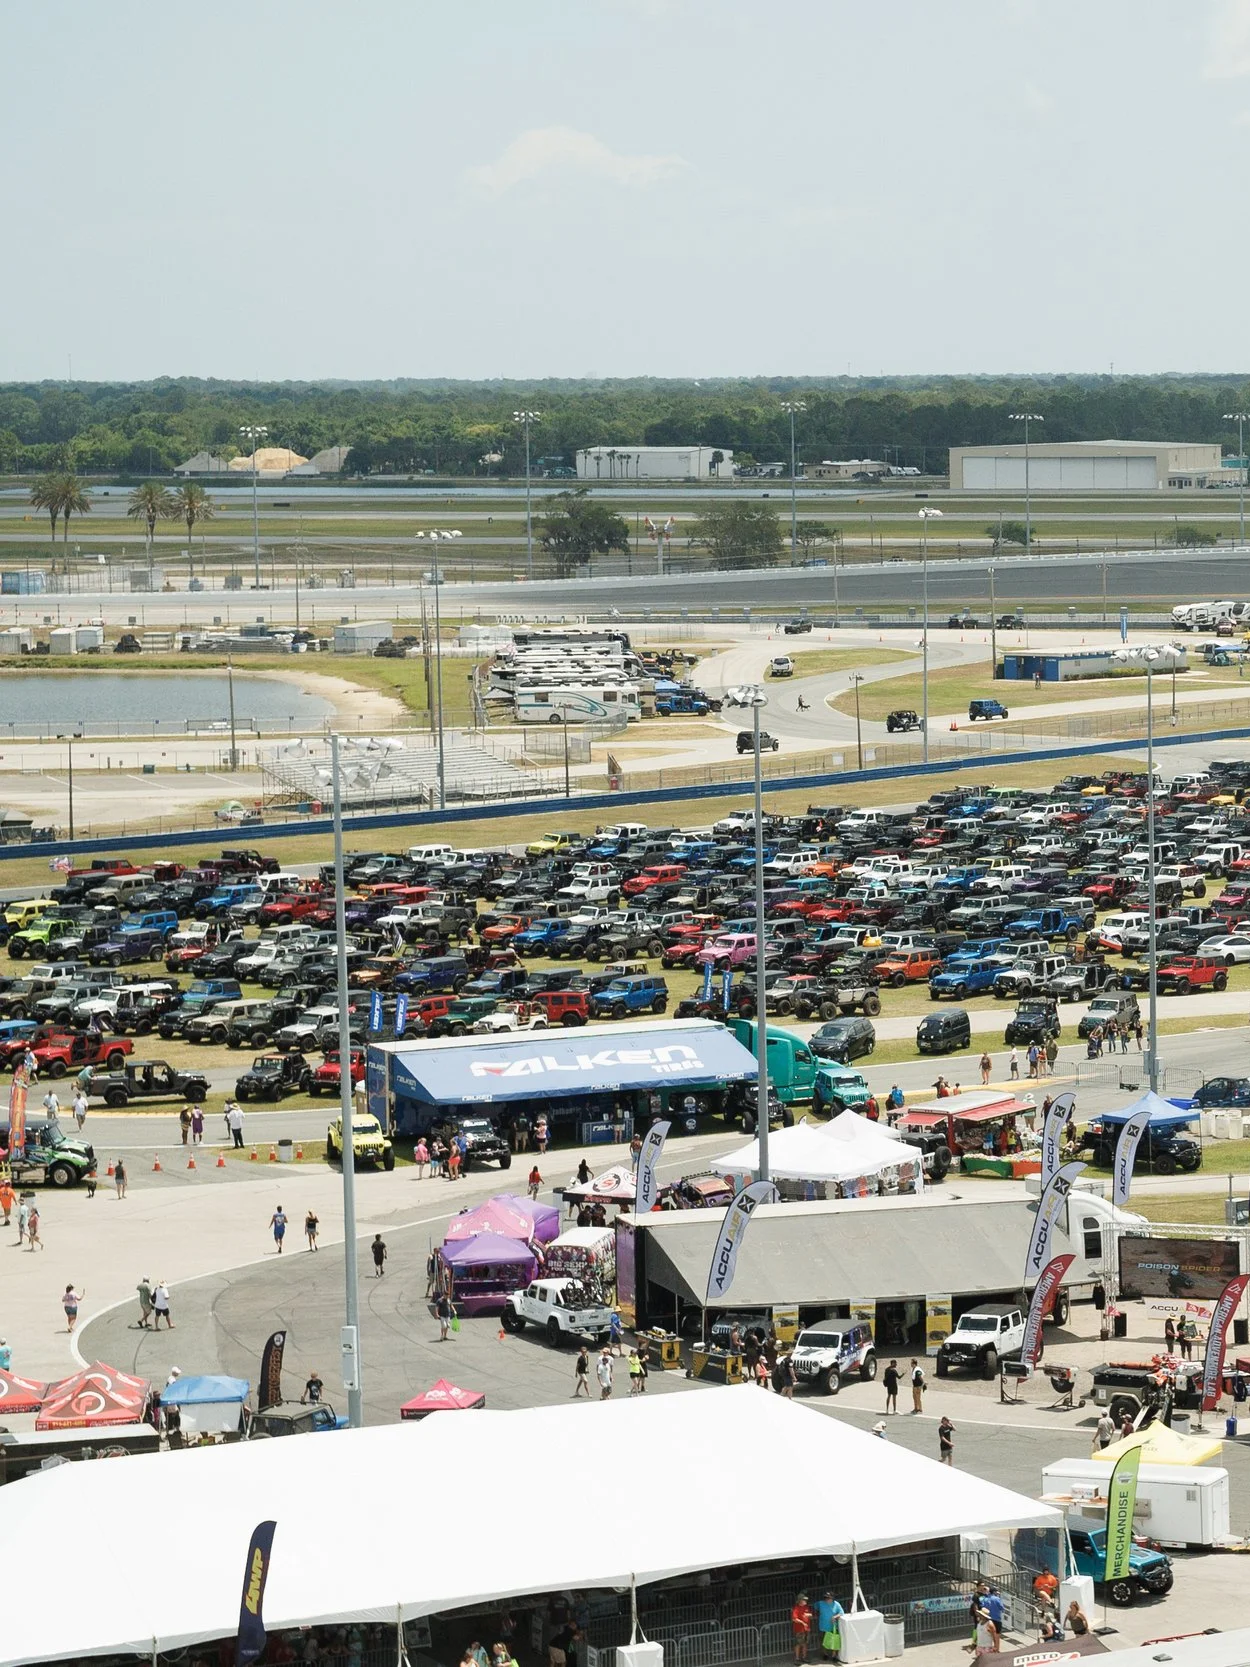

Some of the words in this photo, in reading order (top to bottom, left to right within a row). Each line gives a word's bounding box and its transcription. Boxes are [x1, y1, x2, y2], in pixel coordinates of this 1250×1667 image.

[469, 1045, 699, 1078] FALKEN
[651, 1059, 704, 1073] TIRES
[1137, 1262, 1180, 1272] POISON
[1181, 1264, 1222, 1273] SPIDER
[1112, 1491, 1129, 1577] MERCHANDISE
[1015, 1652, 1060, 1665] MOTO
